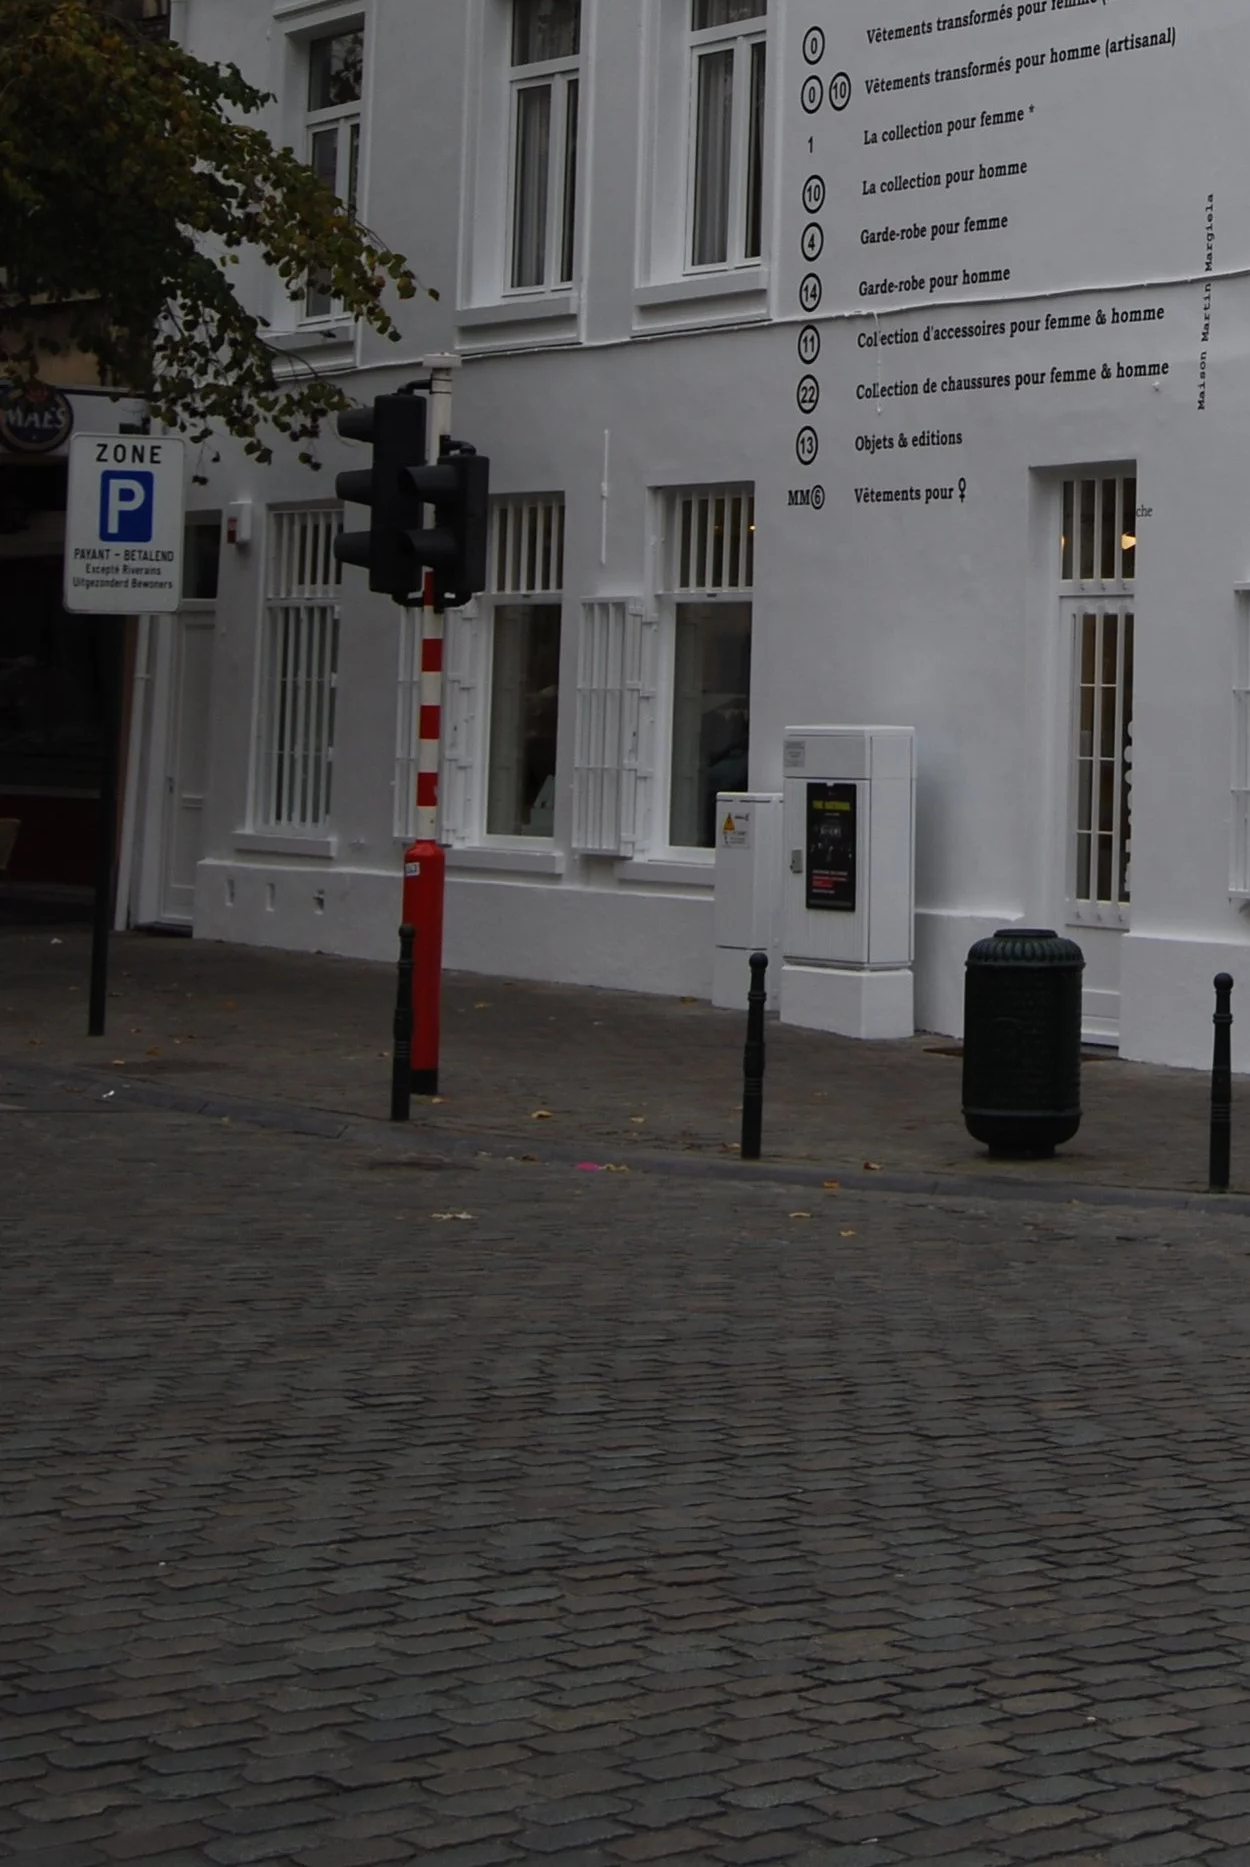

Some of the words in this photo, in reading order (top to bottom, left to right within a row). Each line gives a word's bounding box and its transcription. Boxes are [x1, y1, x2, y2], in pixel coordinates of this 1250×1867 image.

[866, 20, 932, 44] Vêtements
[936, 4, 1012, 31] transformés
[1016, 1, 1047, 21] pour
[865, 71, 930, 94] Vêtements
[935, 56, 1011, 83] transformés
[1015, 53, 1046, 74] pour
[1050, 44, 1101, 63] homme
[1105, 27, 1175, 58] (artisanal)
[808, 136, 813, 153] 1
[864, 130, 878, 145] La
[881, 120, 943, 142] collection
[947, 117, 976, 137] pour
[980, 110, 1024, 127] femme
[862, 180, 876, 195] La
[880, 172, 941, 193] collection
[945, 169, 975, 189] pour
[979, 162, 1027, 179] homme
[860, 223, 927, 244] Garde-robe
[931, 222, 960, 241] pour
[964, 216, 1008, 232] femme
[1205, 194, 1215, 271] Margiela
[859, 275, 925, 296] Garde-robe
[929, 274, 959, 293] pour
[962, 269, 1010, 285] homme
[923, 320, 1005, 341] d'accessoires
[1009, 319, 1041, 338] pour
[1045, 313, 1091, 330] femme
[1095, 309, 1107, 325] &
[1111, 307, 1164, 324] homme
[1201, 282, 1212, 343] Martin
[923, 378, 937, 394] de
[941, 375, 1010, 392] chaussures
[1015, 372, 1046, 391] pour
[1050, 367, 1096, 383] femme
[1101, 363, 1112, 379] &
[1116, 362, 1169, 378] homme
[1197, 352, 1207, 410] Maison
[6, 406, 66, 429] MAES
[96, 443, 162, 464] ZONE
[855, 434, 894, 455] Objets
[898, 433, 908, 448] &
[912, 430, 962, 447] editions
[107, 479, 145, 533] P
[854, 486, 921, 503] Vêtements
[925, 488, 954, 504] pour
[74, 548, 110, 560] PAYANT
[124, 549, 174, 562] BETALEND
[122, 564, 161, 575] Riverains
[73, 577, 129, 590] Uitgezonderd
[131, 578, 173, 589] Bewoners
